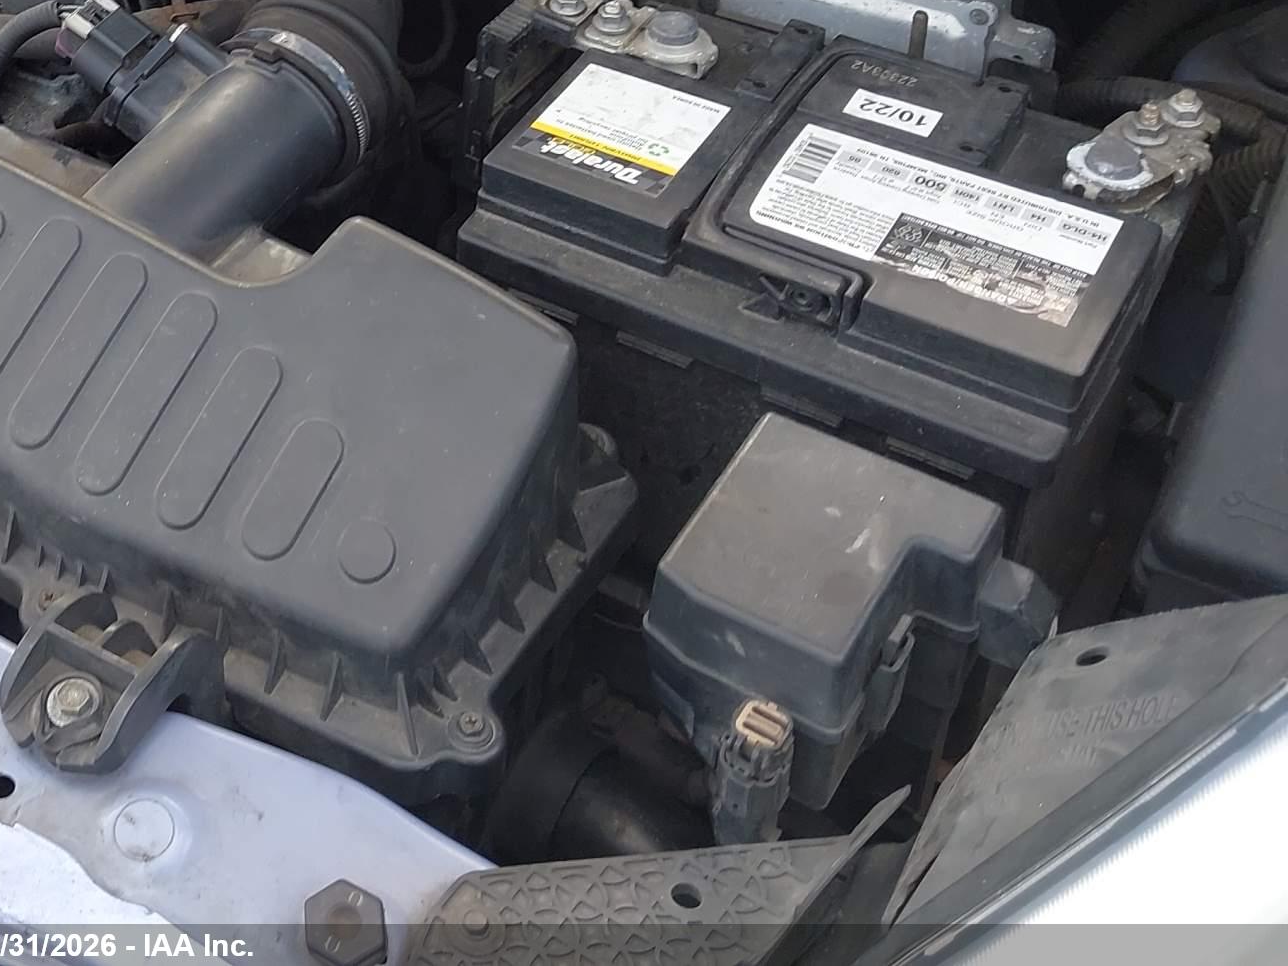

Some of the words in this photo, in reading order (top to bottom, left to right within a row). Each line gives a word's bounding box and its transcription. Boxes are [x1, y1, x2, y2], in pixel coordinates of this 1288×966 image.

[859, 98, 928, 127] 10/22
[540, 138, 643, 185] Duralast
[912, 174, 947, 192] 500
